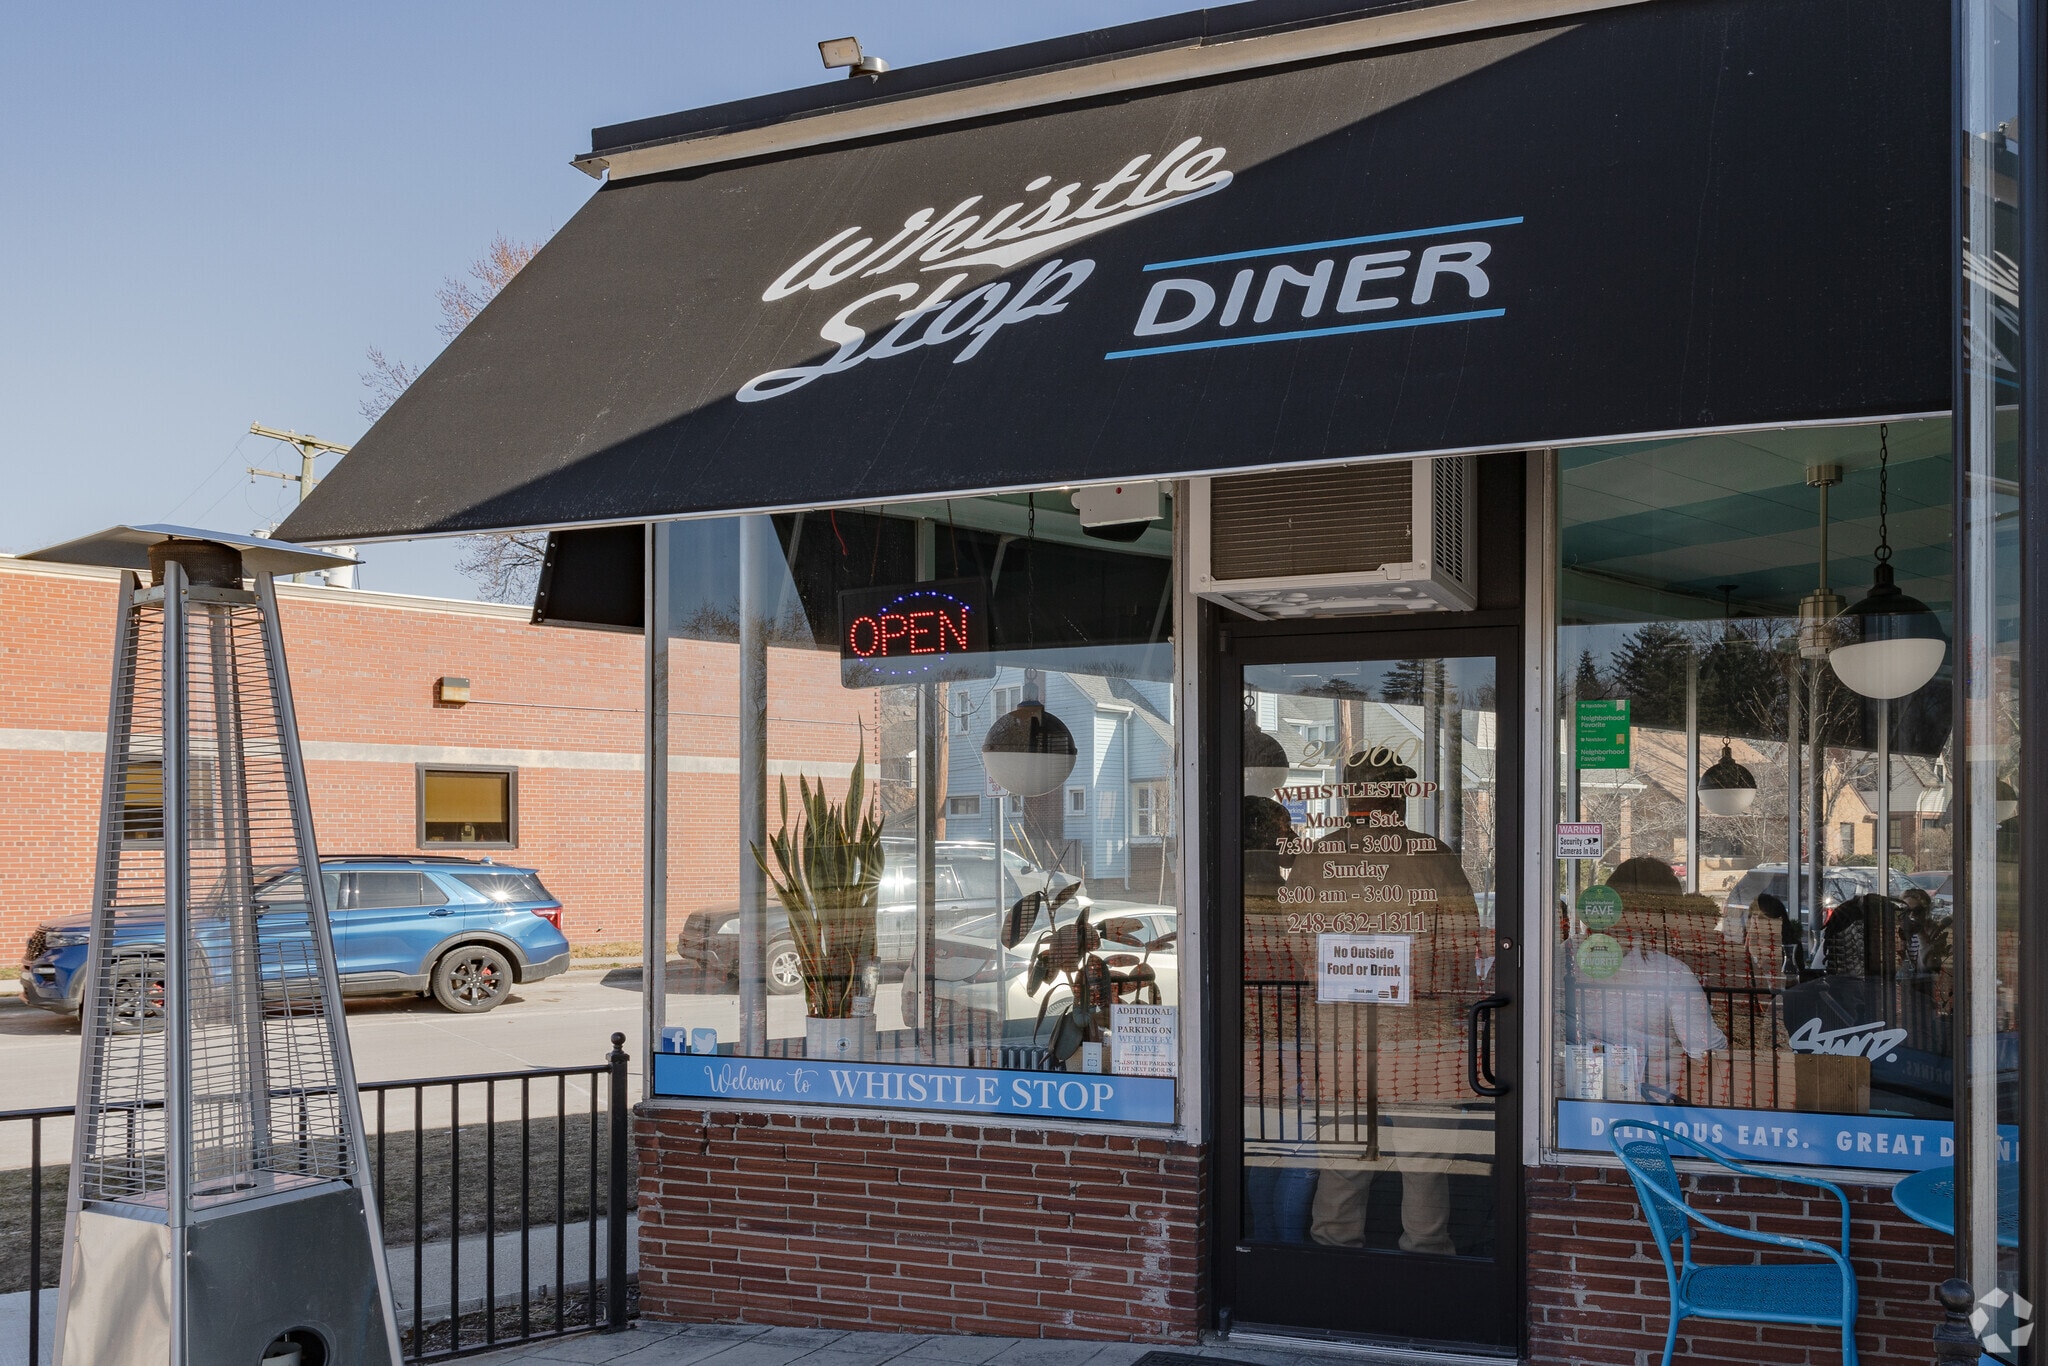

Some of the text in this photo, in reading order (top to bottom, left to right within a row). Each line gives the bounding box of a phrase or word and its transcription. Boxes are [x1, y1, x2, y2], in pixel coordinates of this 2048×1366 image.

[762, 136, 1233, 302] Whistle
[1134, 242, 1492, 336] DINER
[736, 259, 1096, 403] Stop
[850, 608, 968, 656] OPEN
[1273, 781, 1437, 804] WHISTLESTOP
[1306, 812, 1351, 829] Mon.
[1369, 810, 1405, 828] Sat.
[1559, 825, 1600, 834] WARNING
[1276, 837, 1314, 855] 7:30
[1318, 840, 1346, 853] am
[1363, 834, 1402, 853] 3:00
[1406, 837, 1437, 855] pm
[1560, 837, 1583, 846] Security
[1560, 846, 1582, 855] Cameras
[1589, 847, 1599, 855] Use
[1323, 860, 1389, 881] Sunday
[1277, 886, 1315, 903] 8:00
[1319, 889, 1347, 903] am
[1364, 885, 1403, 903] 3:00
[1408, 888, 1438, 906] pm
[1585, 905, 1614, 915] FAVE
[1287, 911, 1427, 934] 248-632-1311
[1333, 945, 1394, 959] No Outside
[1327, 963, 1401, 976] Food or Drink
[1581, 958, 1618, 966] FAVORITE
[1117, 1007, 1172, 1016] ADDITIONAL
[1128, 1016, 1161, 1025] PUBLIC
[1117, 1026, 1172, 1035] PARKING ON
[1119, 1035, 1172, 1045] WELLESLEY
[1131, 1045, 1159, 1053] DRIVE
[704, 1063, 1114, 1112] Welcome to WHISTLE STOP
[1737, 1125, 1809, 1149] EATS.
[1836, 1130, 1924, 1156] GREAT
